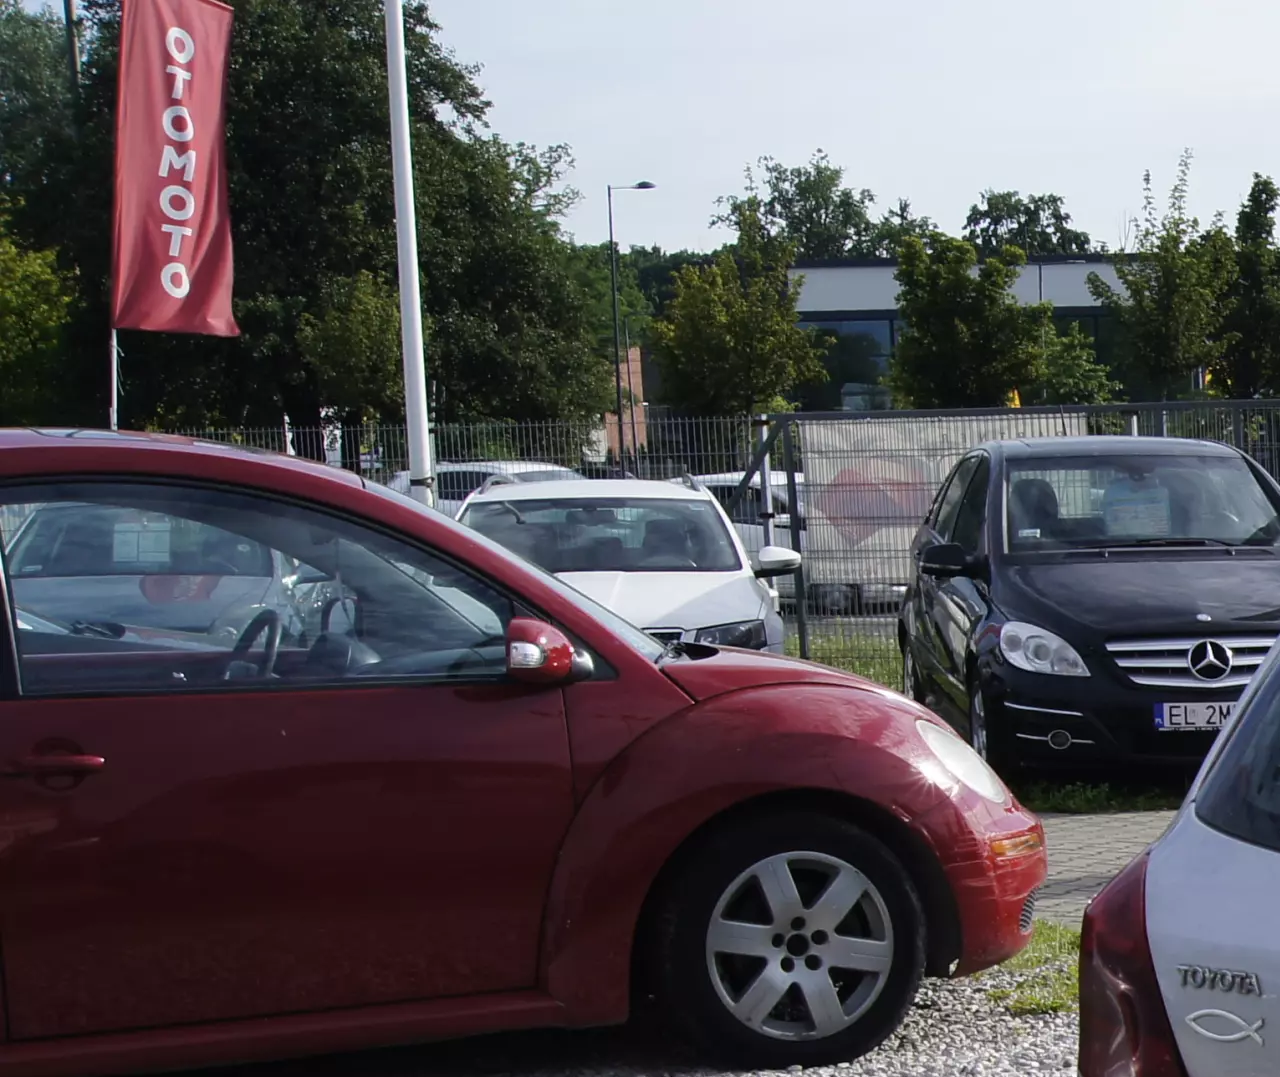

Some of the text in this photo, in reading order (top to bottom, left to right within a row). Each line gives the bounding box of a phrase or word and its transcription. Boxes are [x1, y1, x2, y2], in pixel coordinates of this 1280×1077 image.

[158, 26, 195, 299] OTOMOTO
[1169, 705, 1196, 726] EL
[1206, 705, 1237, 725] 2M
[1176, 964, 1262, 997] TOYOTA
